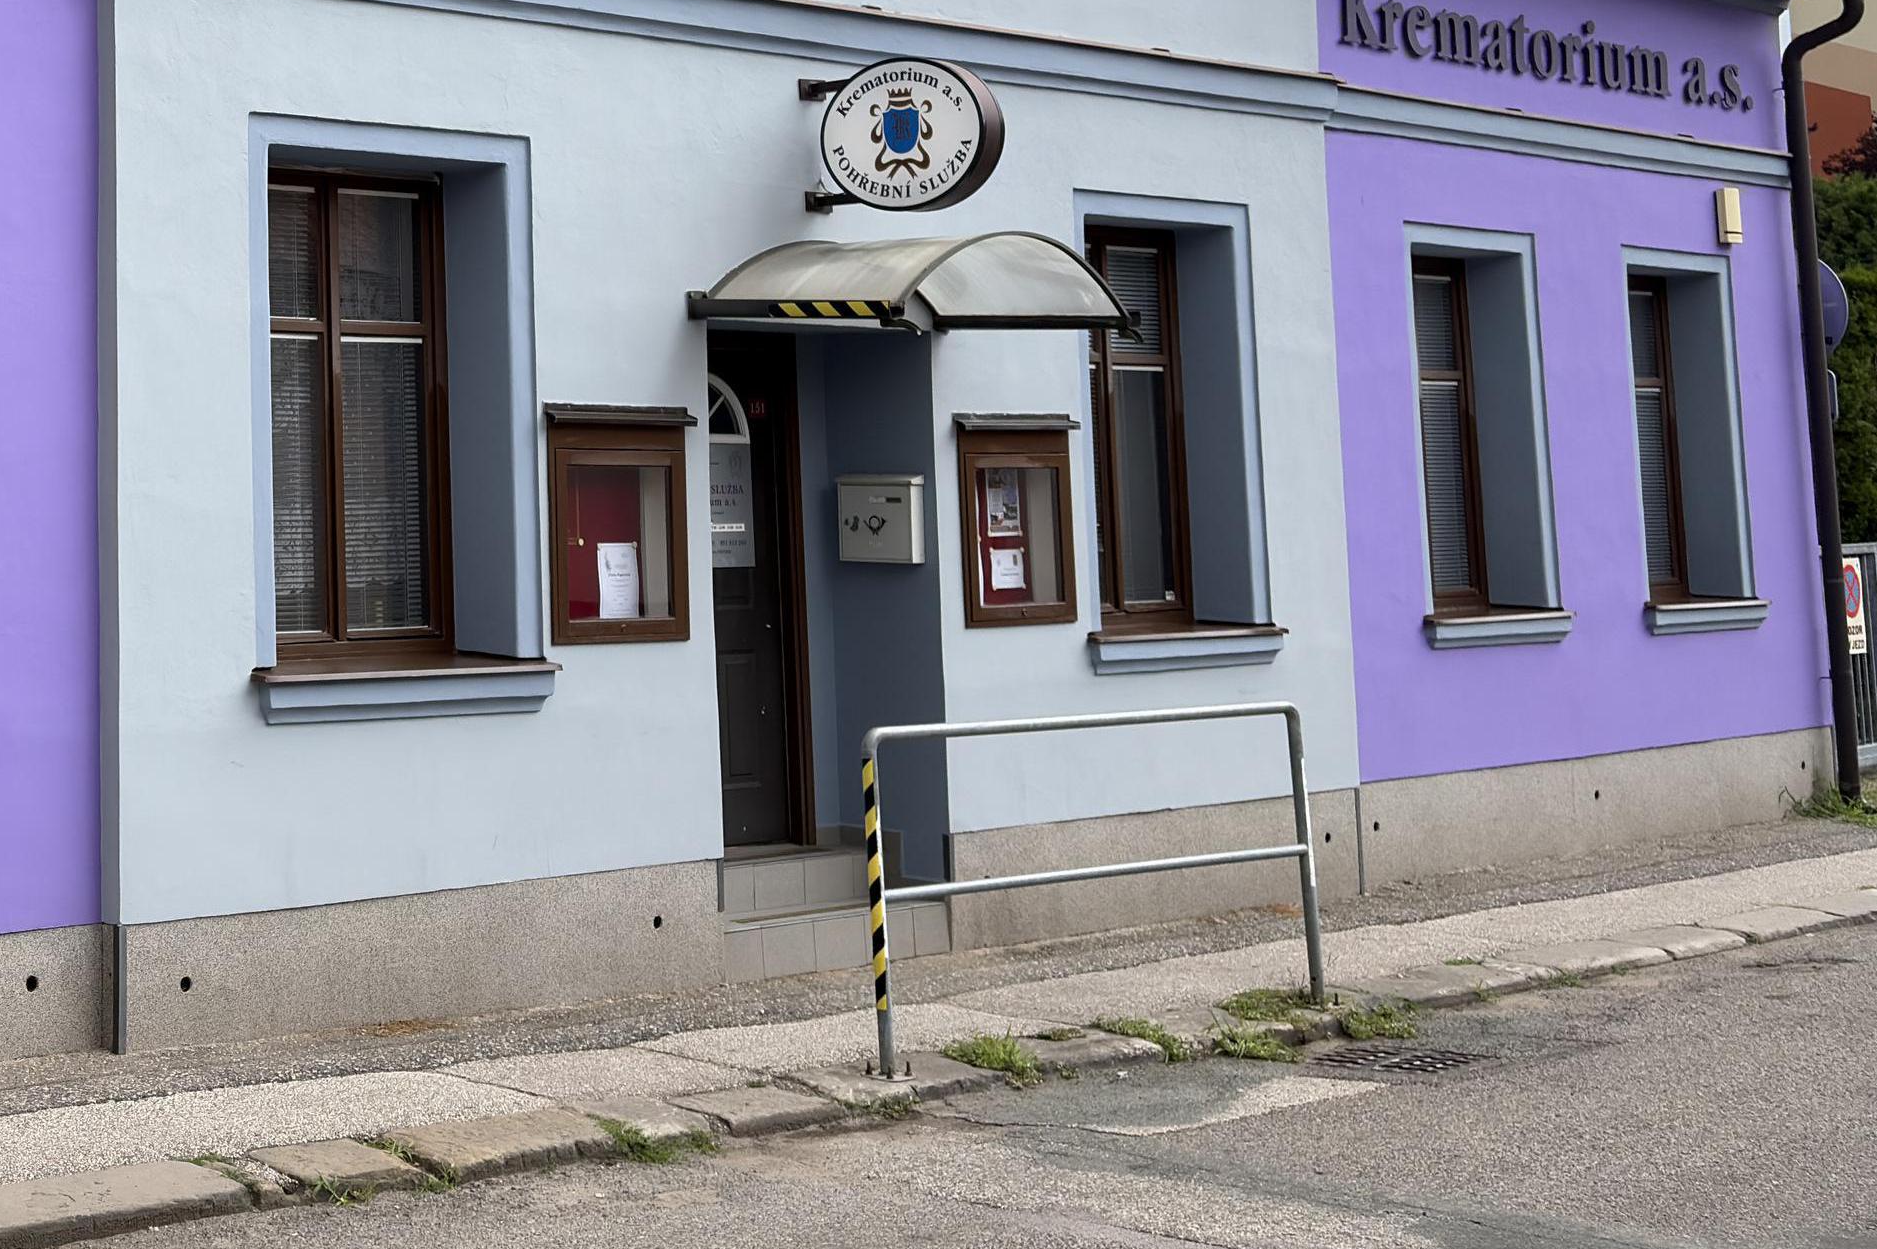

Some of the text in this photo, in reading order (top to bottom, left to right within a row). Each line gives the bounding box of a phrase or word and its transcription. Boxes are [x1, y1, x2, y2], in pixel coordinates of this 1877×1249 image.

[835, 67, 964, 118] Krematorium a.s.
[1683, 55, 1754, 112] a.s.
[832, 137, 973, 199] POHŘEBNÍ SLUŽBA
[1847, 624, 1863, 635] OZOR
